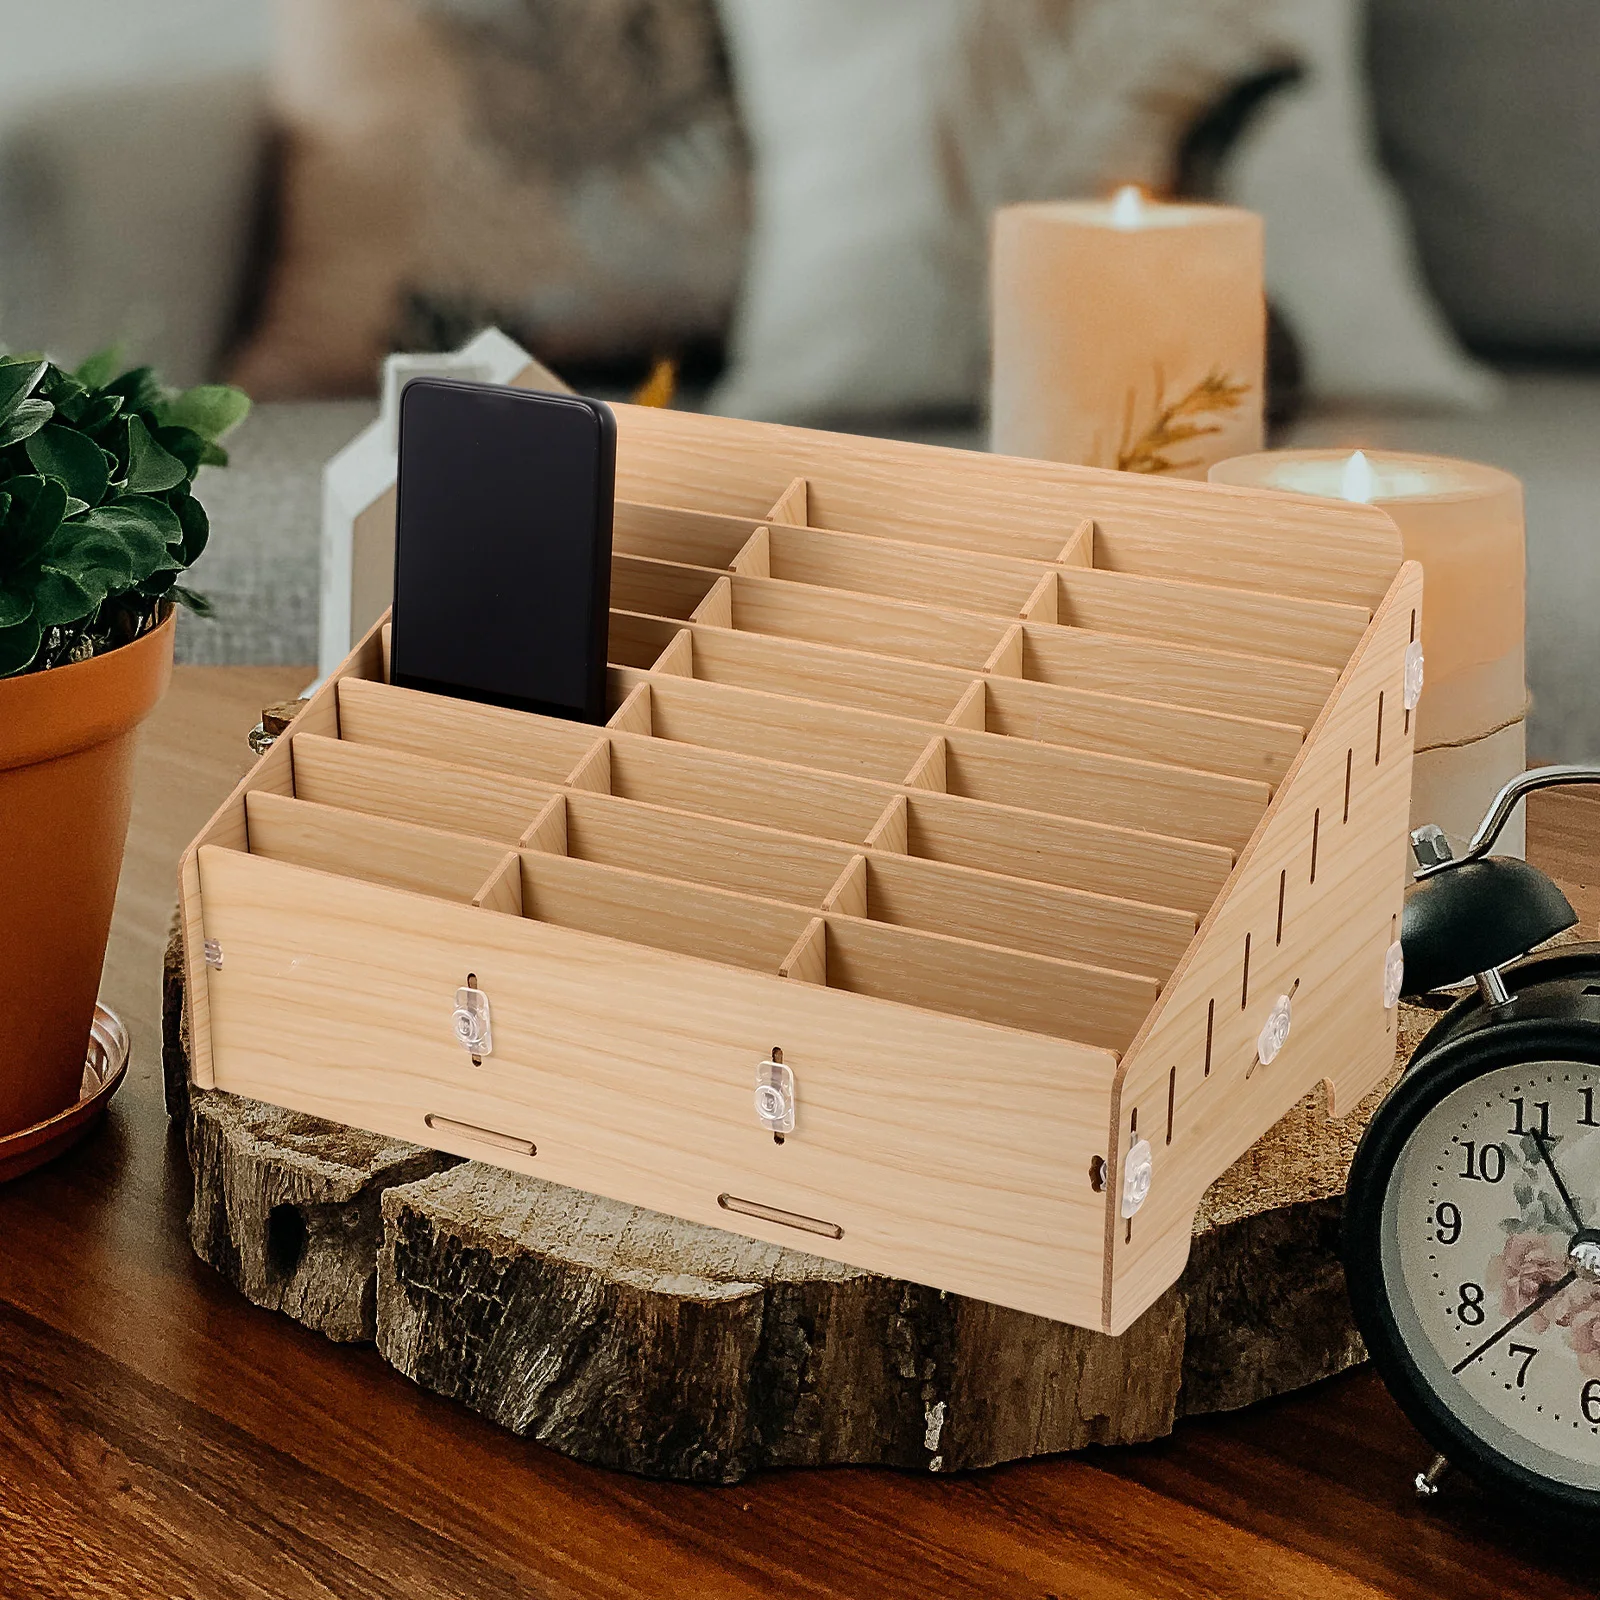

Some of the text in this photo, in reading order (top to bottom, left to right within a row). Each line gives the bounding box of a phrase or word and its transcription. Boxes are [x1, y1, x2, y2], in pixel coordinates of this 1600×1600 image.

[1507, 1097, 1556, 1141] 11
[1459, 1141, 1505, 1183] 10
[1435, 1202, 1462, 1245] 9
[1457, 1282, 1485, 1326] 8
[1508, 1342, 1538, 1388] 7
[1580, 1379, 1600, 1424] 6
